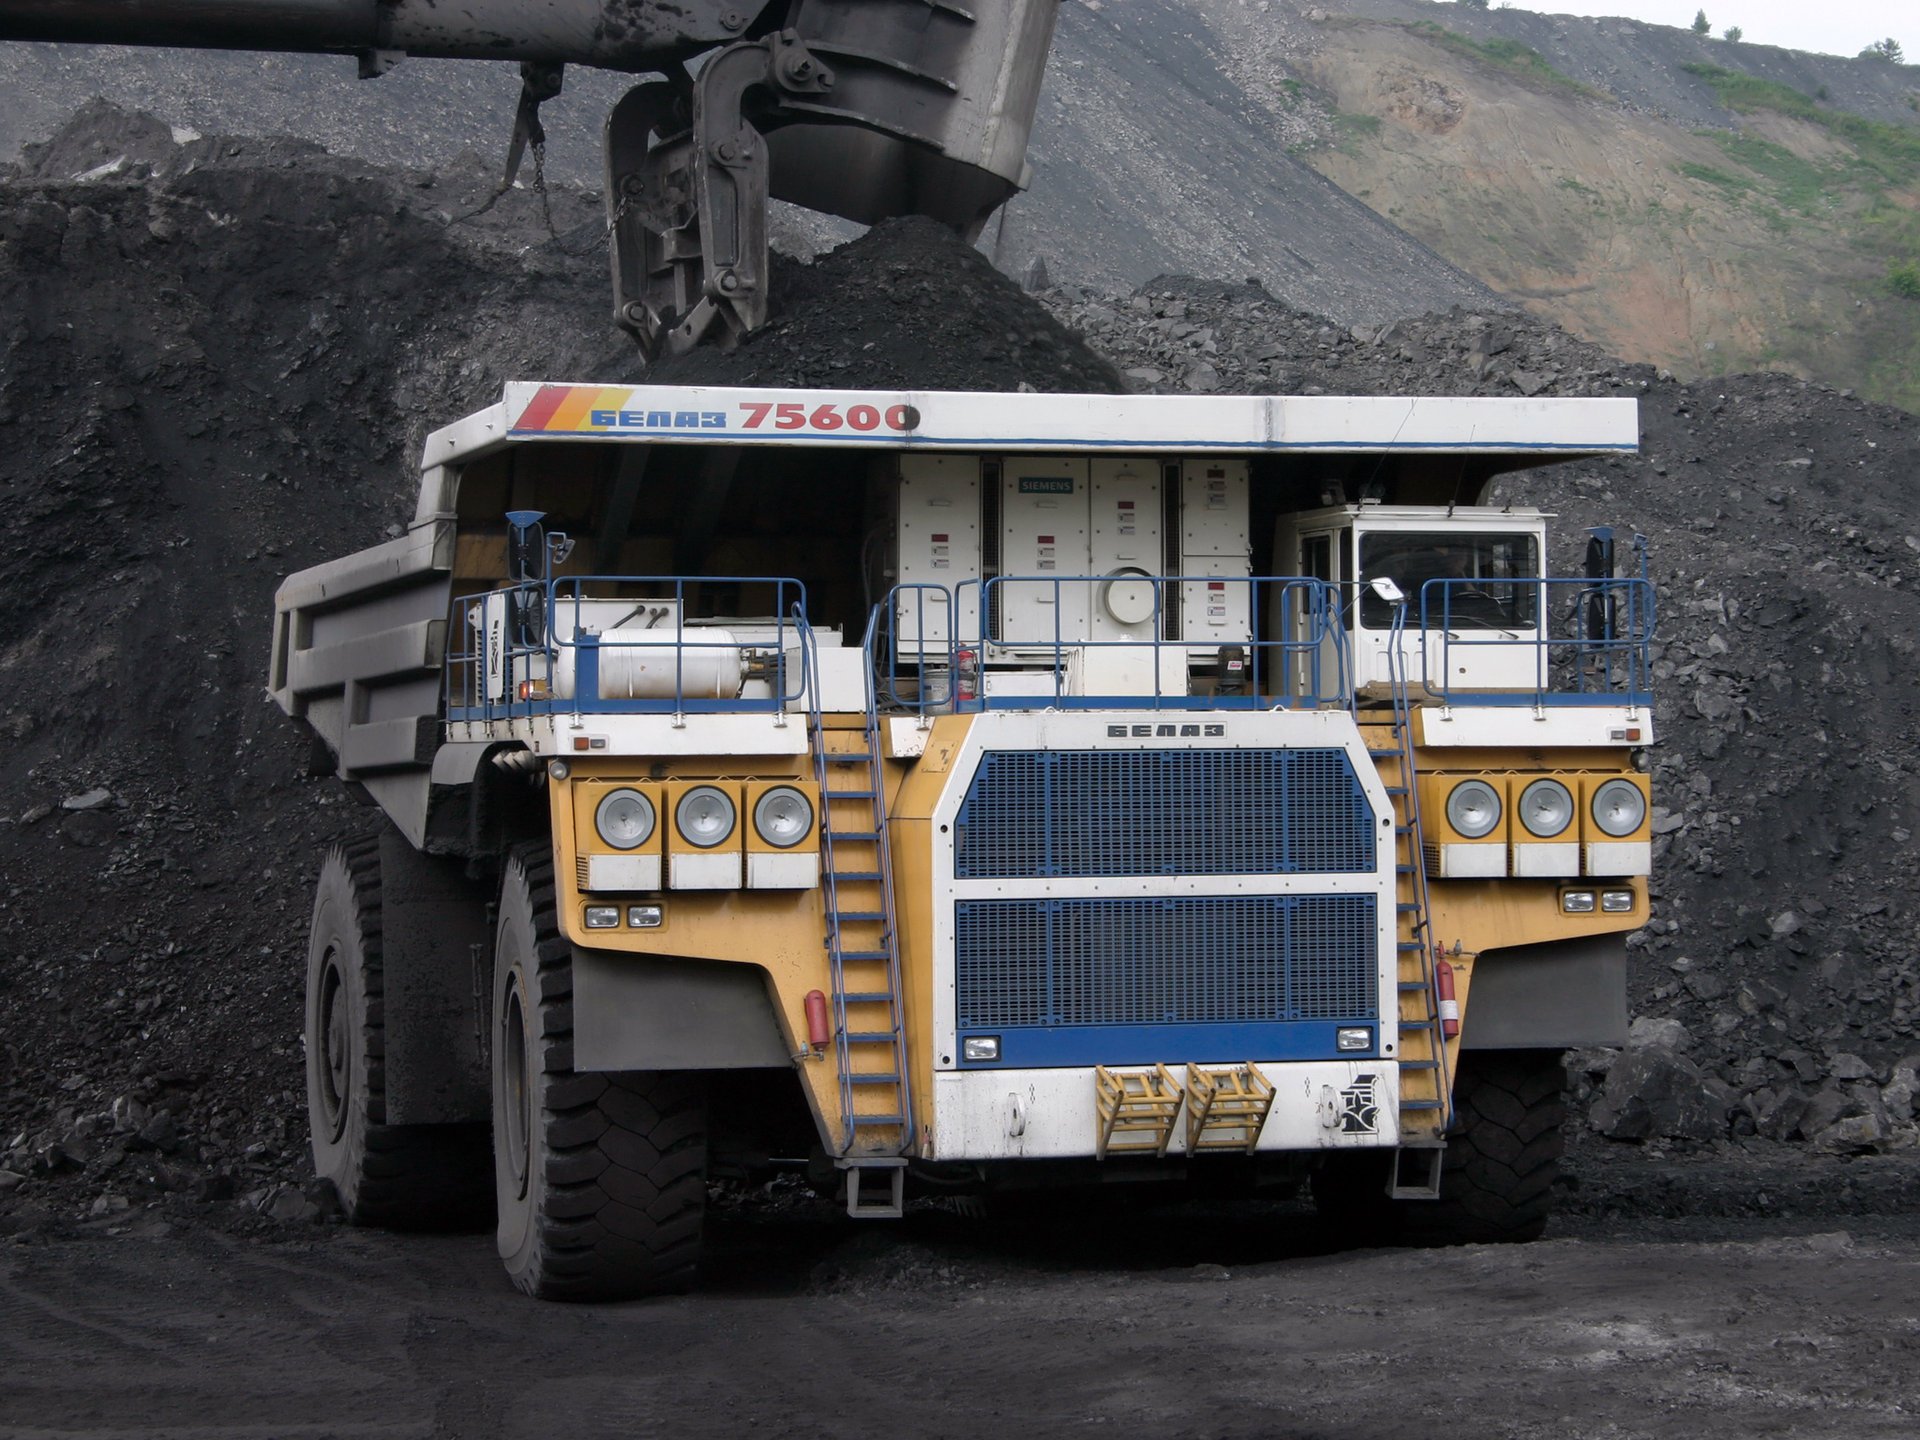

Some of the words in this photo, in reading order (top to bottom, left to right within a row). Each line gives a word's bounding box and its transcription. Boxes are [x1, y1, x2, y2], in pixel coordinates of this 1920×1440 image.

[590, 409, 727, 428] БЕЛАЗ
[739, 402, 919, 431] 75600
[1022, 480, 1072, 491] SIEMENS
[1107, 724, 1225, 738] БЕЛАЗ
